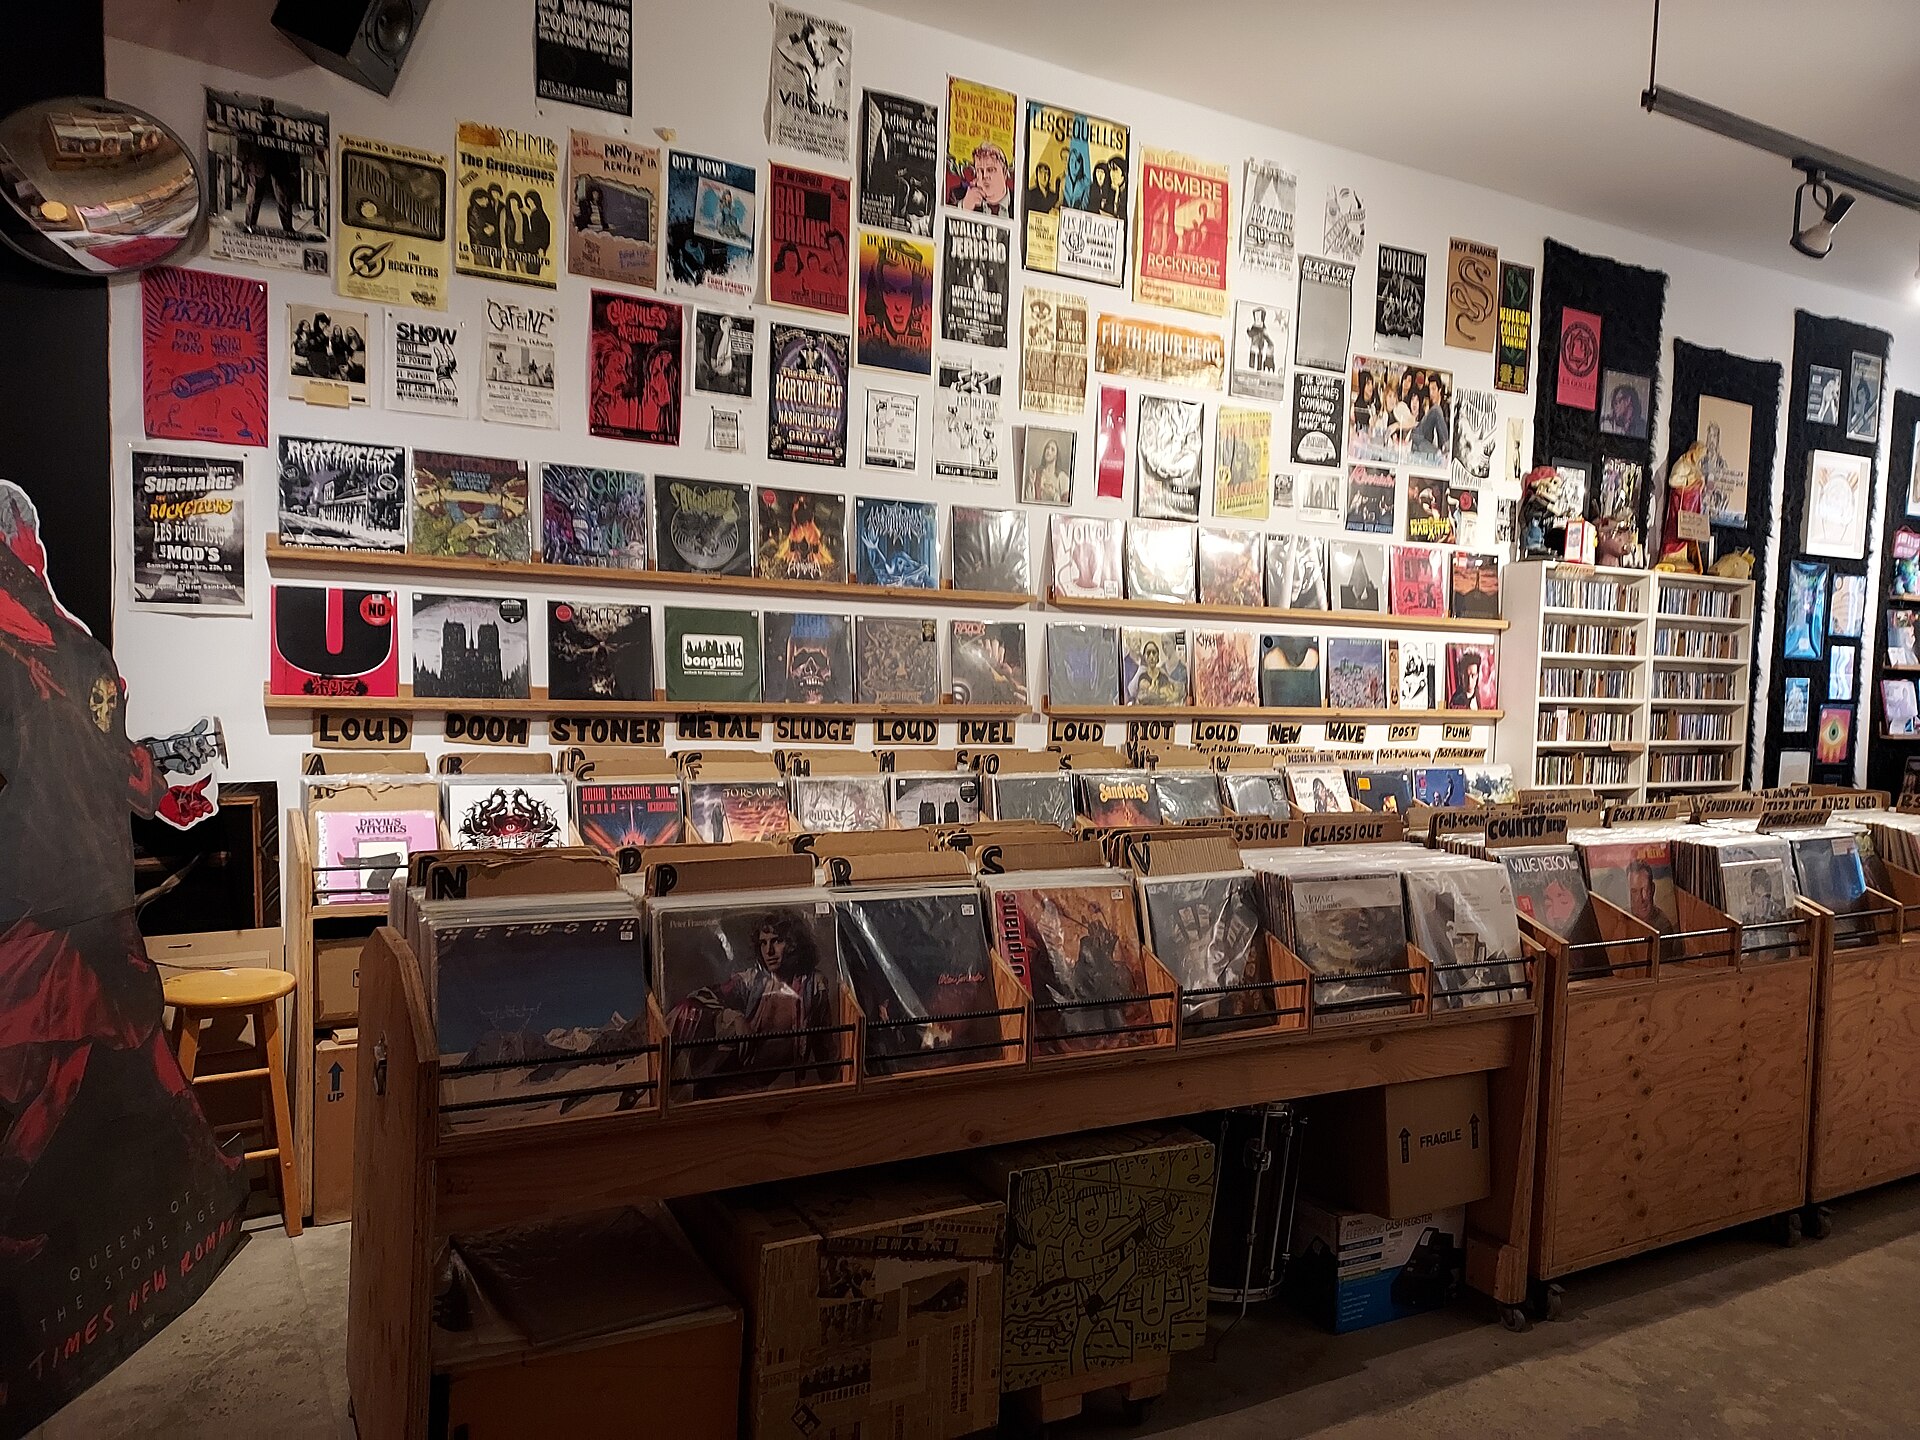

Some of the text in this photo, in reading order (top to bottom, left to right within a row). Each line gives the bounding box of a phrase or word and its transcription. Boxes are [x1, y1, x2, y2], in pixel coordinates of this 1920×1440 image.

[257, 136, 314, 156] FUCK THE FACTS
[374, 142, 388, 154] 30
[604, 143, 632, 162] PARTY
[460, 152, 555, 182] The Gruesomes
[671, 154, 727, 177] OUT NOW!
[391, 178, 441, 236] DIVISION
[775, 186, 830, 250] BAD BRAINS
[949, 218, 998, 241] WALLS OF
[407, 250, 420, 262] The
[951, 235, 1006, 263] JERICHO
[1451, 239, 1497, 258] HOT SNAKES
[388, 258, 439, 279] ROCKETEERS
[1303, 259, 1331, 275] BLACK
[1332, 264, 1353, 279] LOVE
[1380, 248, 1424, 278] COLISEUM
[951, 284, 973, 301] WITH
[161, 297, 251, 332] PIRANHA
[396, 321, 457, 345] SHOW
[1102, 321, 1221, 362] FIFTH HOUR HERO
[782, 367, 836, 384] The Reverend
[775, 373, 844, 408] HORTON HEAT
[778, 409, 838, 430] NASHVILLE PUSSY
[144, 475, 235, 494] SURCHARGE
[150, 499, 233, 520] ROCKETEERS
[154, 521, 172, 543] LES
[167, 545, 220, 563] MOD'S
[367, 603, 386, 616] NO
[953, 622, 986, 636] RAZOR
[684, 652, 743, 670] bongzilla
[319, 713, 408, 744] LOUD
[445, 713, 528, 744] DOOM
[551, 717, 661, 744] STONER
[678, 714, 760, 739] METAL
[777, 717, 854, 742] SLUDGE
[877, 719, 937, 743] LOUD
[960, 720, 1013, 743] PWEL
[1051, 719, 1103, 742] LOUD
[1129, 720, 1174, 741] RIOT
[1196, 721, 1239, 741] LOUD
[1269, 723, 1302, 743] NEW
[1327, 722, 1365, 743] WAVE
[1391, 725, 1416, 738] POST
[1446, 726, 1471, 739] PUNK
[794, 758, 810, 777] H
[880, 751, 895, 772] M
[1059, 754, 1073, 771] S
[582, 785, 652, 801] DOOM SESSIONS
[1099, 782, 1149, 803] Sandveiss
[1825, 796, 1877, 809] JAZZ USED
[1705, 798, 1755, 813] SOUNDTRACK
[355, 824, 407, 834] WITCHES
[359, 817, 402, 827] DEVIL'S
[1488, 815, 1566, 840] COUNTRY NEW
[1310, 824, 1383, 843] CLASSIQUE
[981, 846, 1005, 874] S
[1129, 842, 1151, 876] V
[433, 864, 468, 900] N
[655, 864, 678, 897] P
[833, 857, 852, 886] R
[441, 919, 636, 941] NETWORK
[669, 919, 720, 930] Peter Frampton
[327, 1092, 344, 1102] UP
[1419, 1129, 1462, 1149] FRAGILE
[69, 1191, 191, 1282] QUEENS OF
[1345, 1213, 1433, 1241] ELECTRONIC CASH REGISTER
[39, 1201, 216, 1333] THE STONE AGE
[28, 1304, 115, 1381] TIMES
[128, 1265, 168, 1316] NEW
